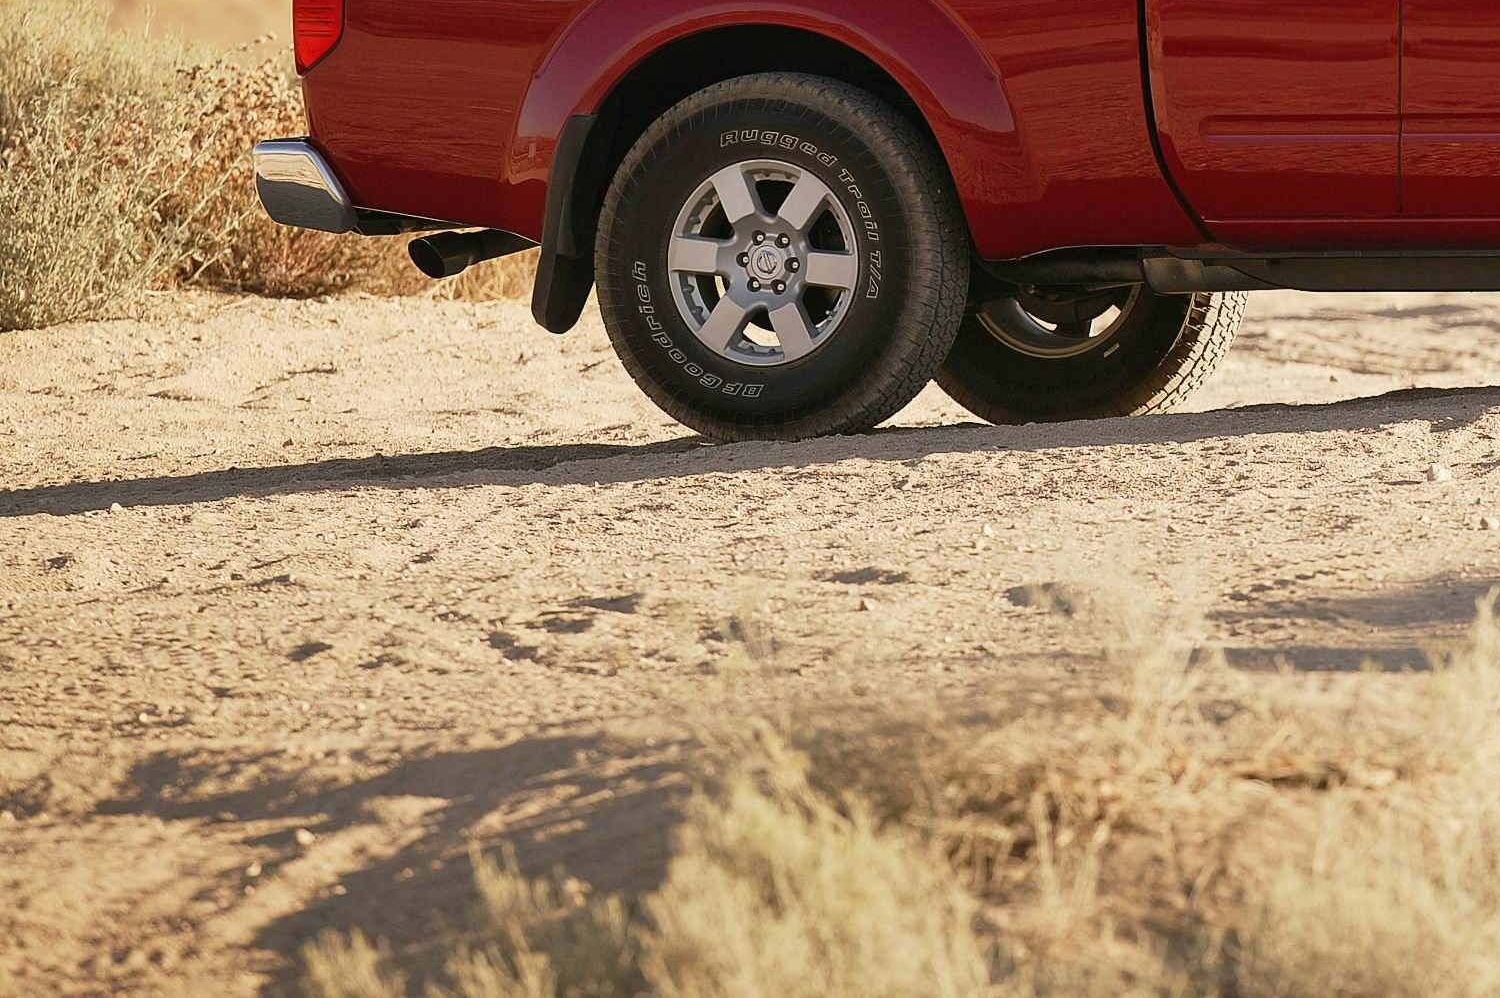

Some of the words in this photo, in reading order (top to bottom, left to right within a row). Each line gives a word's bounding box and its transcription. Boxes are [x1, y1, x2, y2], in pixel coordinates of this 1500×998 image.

[720, 129, 838, 168] Rugged
[838, 168, 880, 241] Trail
[866, 250, 882, 299] T/A
[631, 261, 764, 398] BFGoodrich
